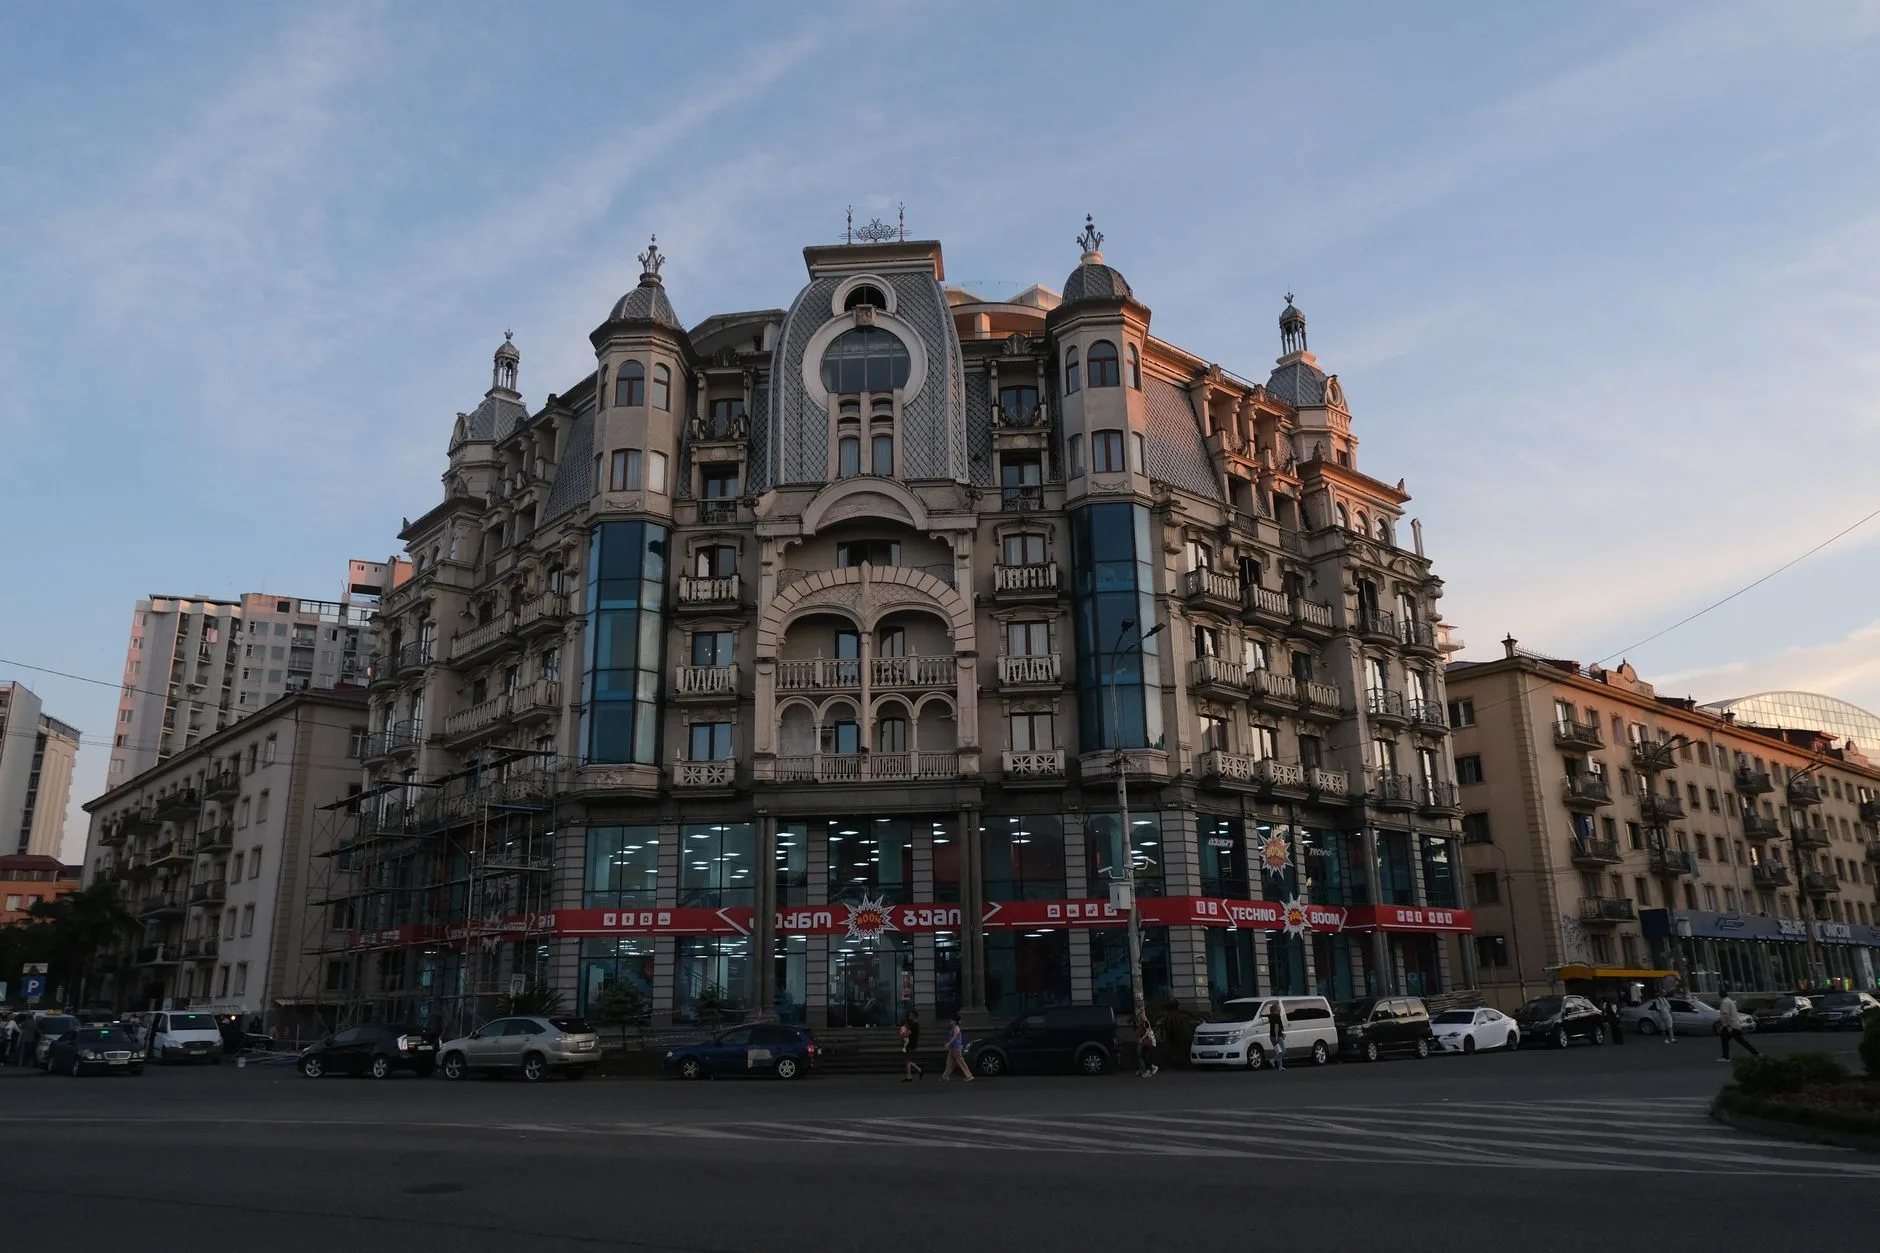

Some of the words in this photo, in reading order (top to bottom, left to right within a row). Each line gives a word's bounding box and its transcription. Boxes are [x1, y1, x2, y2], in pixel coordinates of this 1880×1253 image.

[856, 913, 882, 925] BOOM
[1231, 907, 1276, 921] TECHNO
[1311, 911, 1340, 925] BOOM
[28, 980, 39, 993] P
